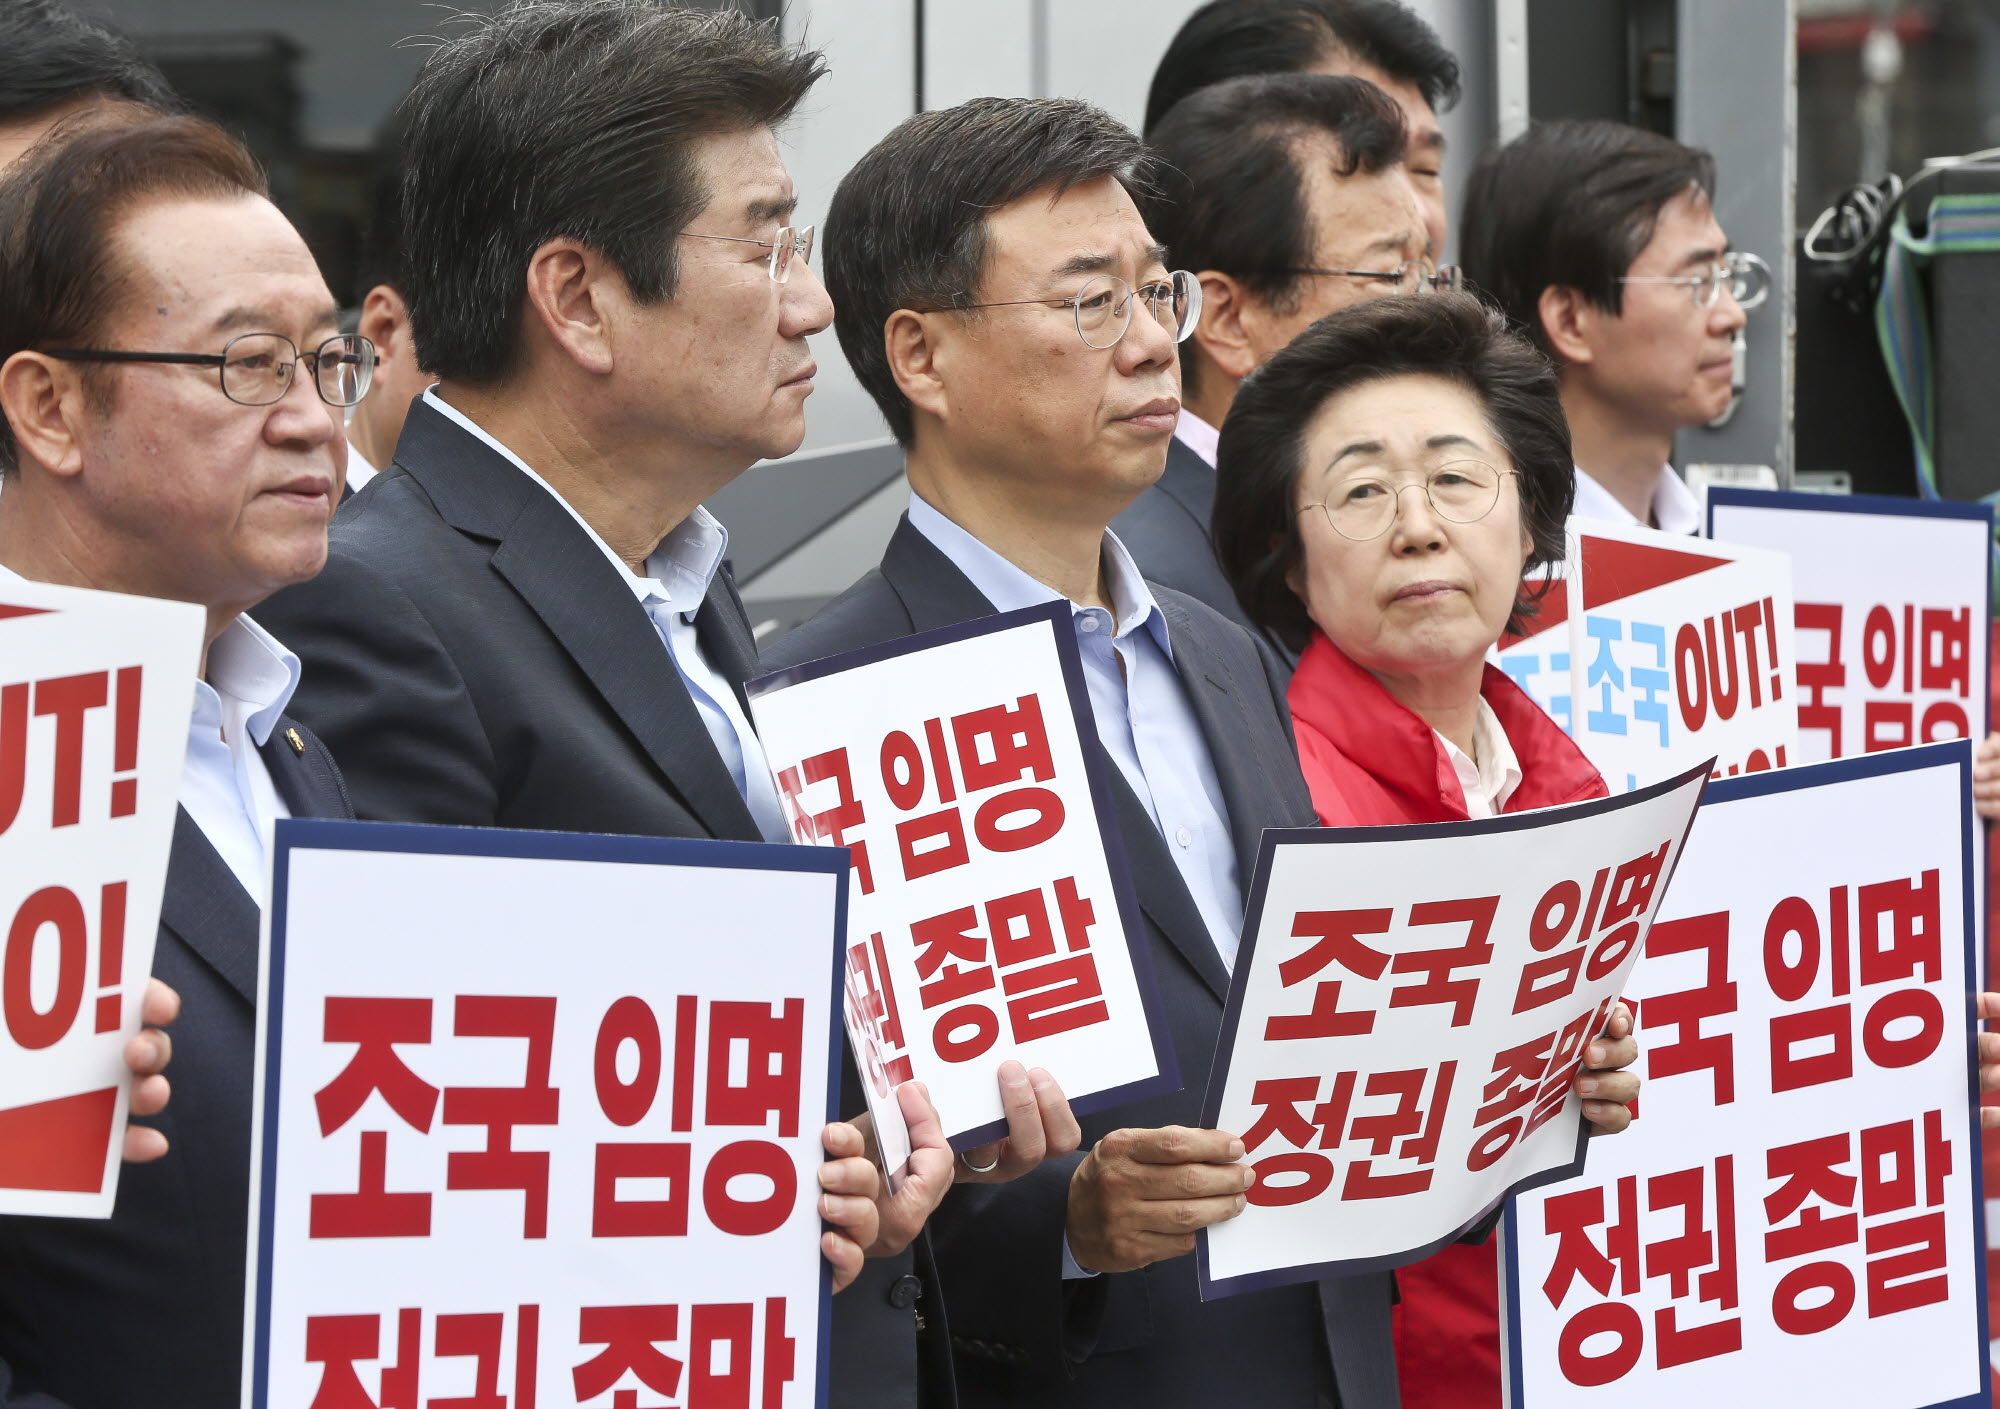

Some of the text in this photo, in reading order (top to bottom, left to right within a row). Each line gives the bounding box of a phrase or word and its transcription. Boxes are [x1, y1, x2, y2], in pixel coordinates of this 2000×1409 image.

[1587, 615, 1670, 748] 조국
[1675, 596, 1782, 733] OUT!
[1795, 602, 1970, 760] 국 임명
[880, 693, 1066, 881] 임명
[909, 876, 1109, 1064] 종말
[1264, 839, 1672, 1041] 조국 임명
[1617, 868, 1944, 1120] 국 임명
[309, 994, 805, 1240] 조국 임명
[1245, 994, 1613, 1207] 정권 종말
[1542, 1109, 1953, 1387] 정권 종말
